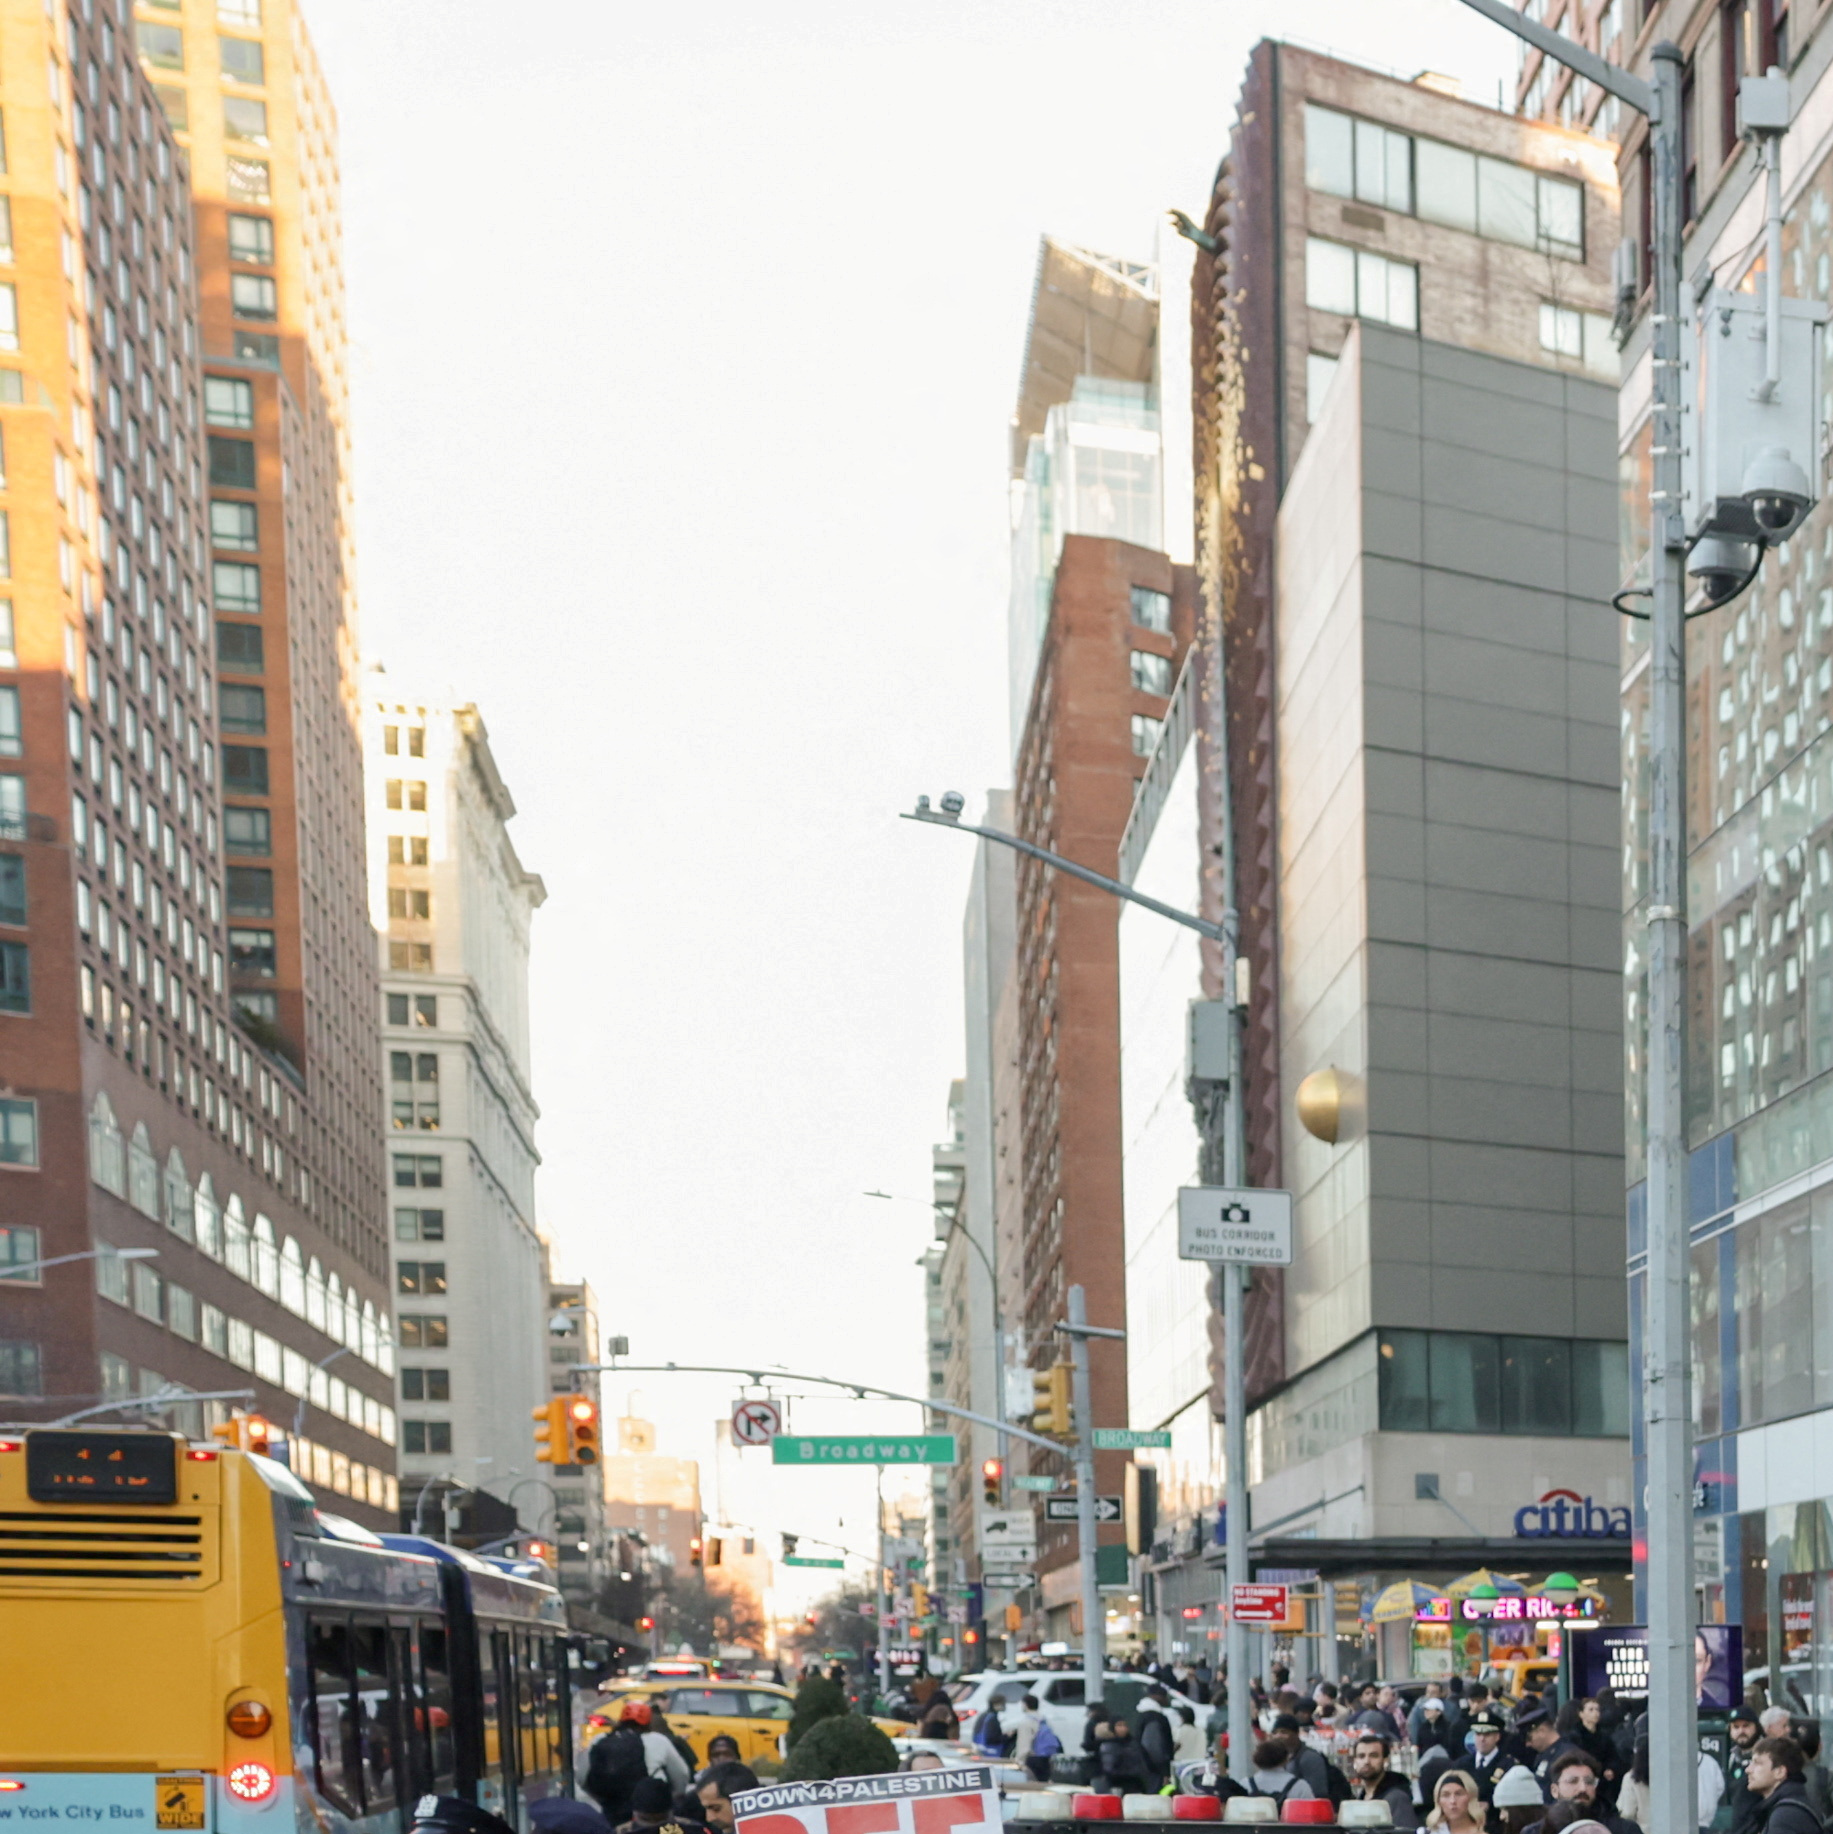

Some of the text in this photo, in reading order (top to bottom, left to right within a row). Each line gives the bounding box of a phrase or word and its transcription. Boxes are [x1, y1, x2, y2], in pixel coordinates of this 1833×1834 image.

[1196, 1228, 1276, 1241] BUS CORRIDOR
[1189, 1244, 1283, 1259] PHOTO ENFORCED
[1099, 1431, 1167, 1446] BROADWAY
[798, 1441, 928, 1462] Broadway
[1514, 1493, 1632, 1537] citiba
[1700, 1738, 1720, 1753] Sq
[18, 1805, 61, 1820] York
[65, 1804, 104, 1822] City
[110, 1804, 145, 1820] Bus
